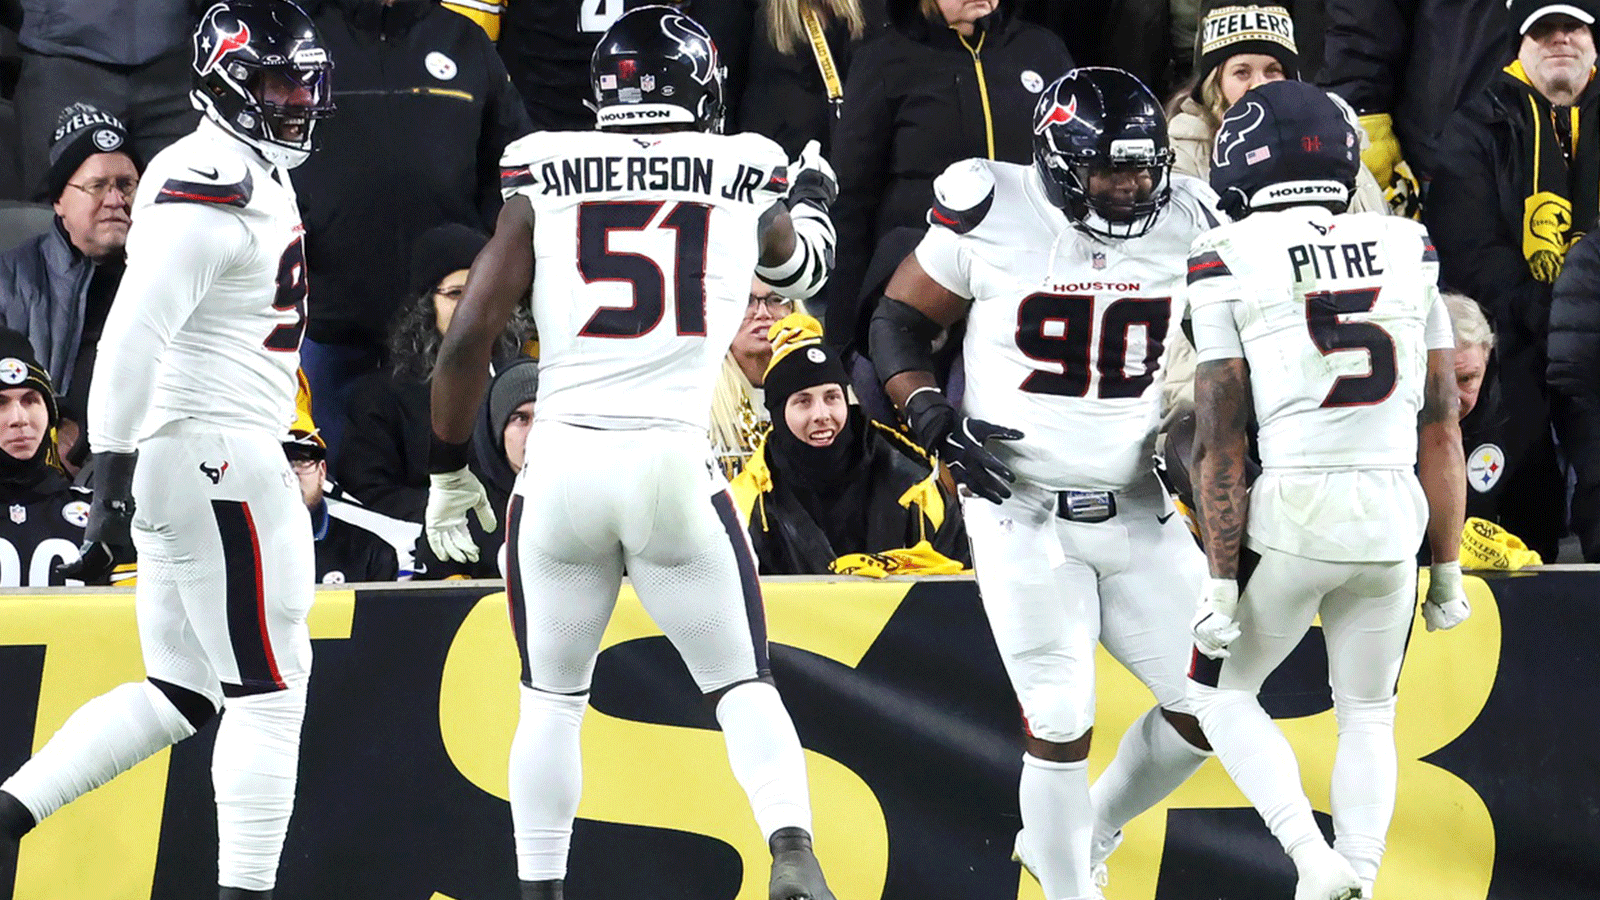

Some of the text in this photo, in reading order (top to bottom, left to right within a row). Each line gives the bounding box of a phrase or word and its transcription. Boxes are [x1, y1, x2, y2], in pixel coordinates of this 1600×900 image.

[1202, 12, 1290, 43] STEELERS
[600, 110, 671, 122] HOUSTON
[541, 156, 764, 204] ANDERSON JR
[1268, 185, 1342, 198] HOUSTON
[576, 200, 716, 339] 51
[1287, 240, 1384, 283] PITRE
[1053, 281, 1141, 292] HOUSTON
[1014, 291, 1172, 400] 90
[1303, 286, 1399, 409] 5
